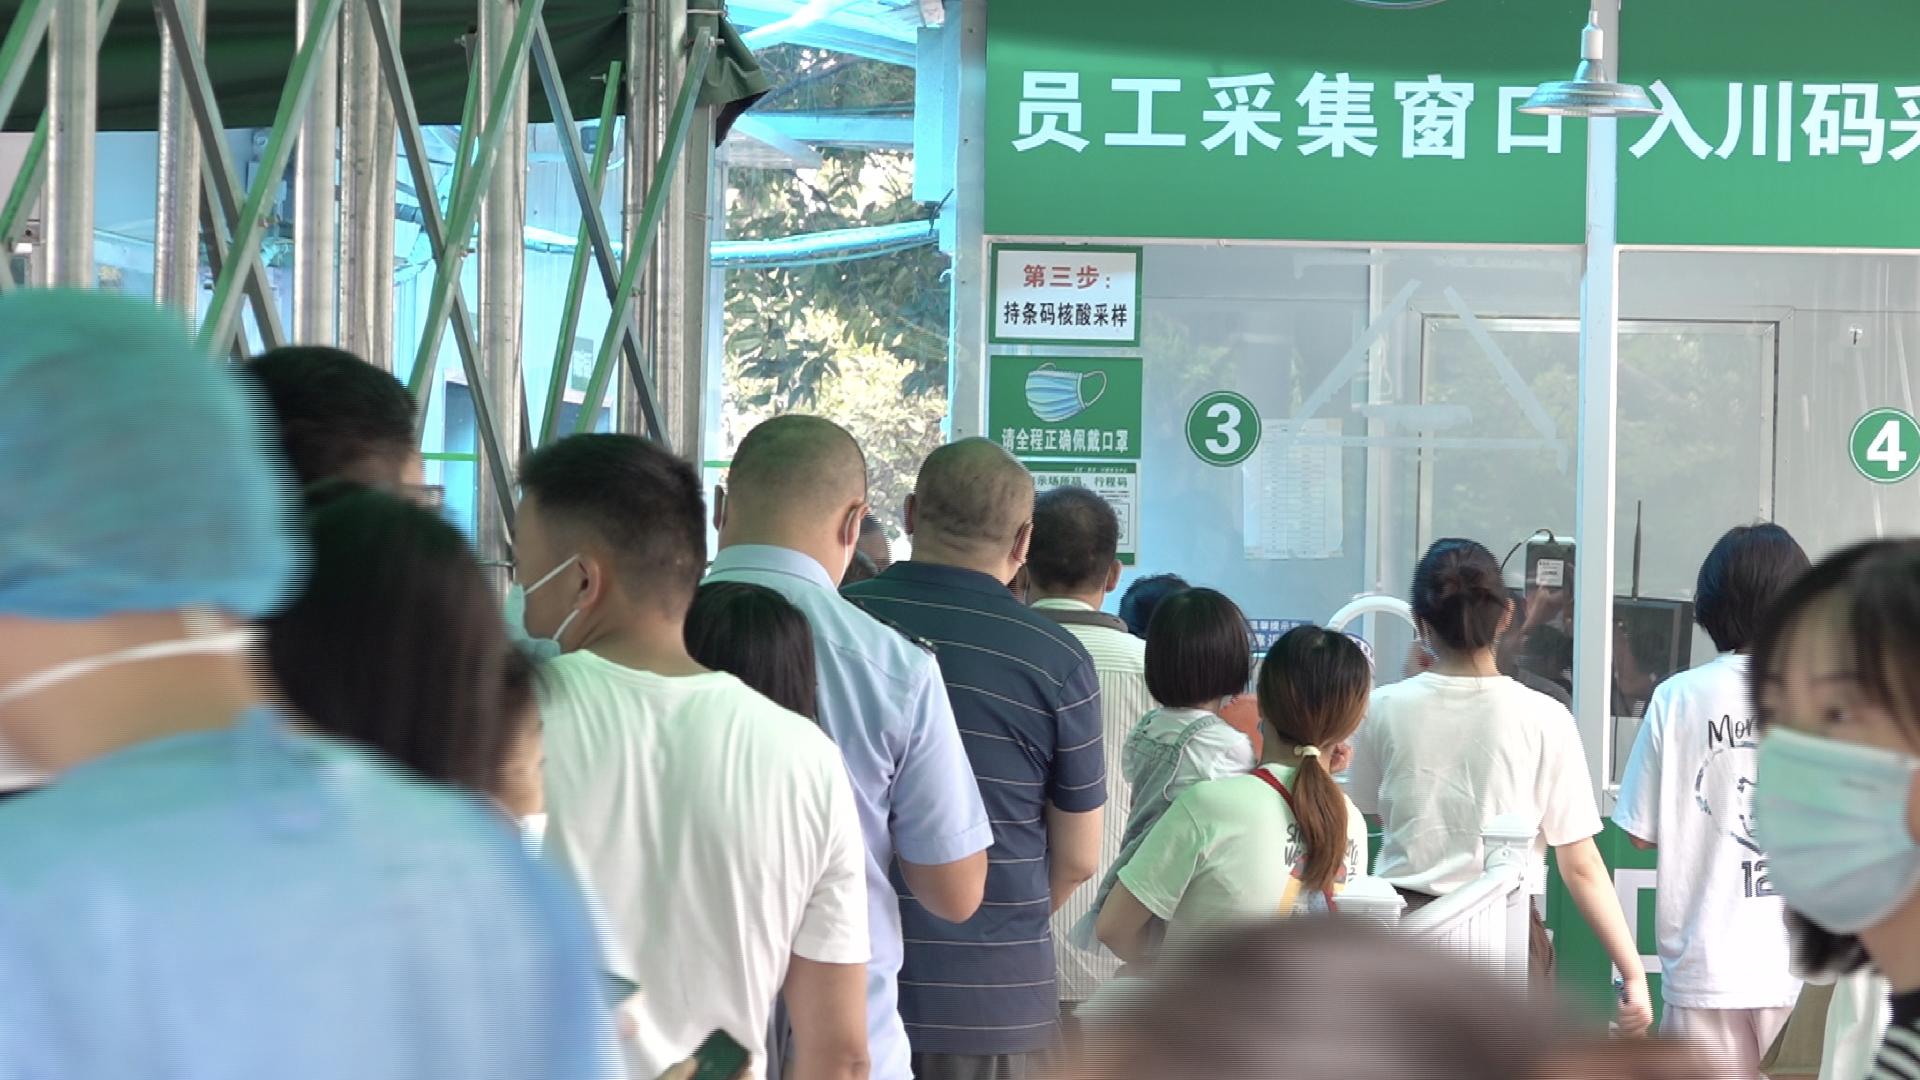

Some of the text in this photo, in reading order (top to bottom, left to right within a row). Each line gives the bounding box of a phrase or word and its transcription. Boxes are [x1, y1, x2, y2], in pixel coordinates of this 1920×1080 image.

[1011, 70, 1562, 159] 员工采集窗口
[1003, 301, 1127, 327] 持条码核酸采样
[1002, 427, 1129, 453] 请全程正确佩戴口罩
[1205, 402, 1242, 455] 3
[1866, 420, 1907, 472] 4
